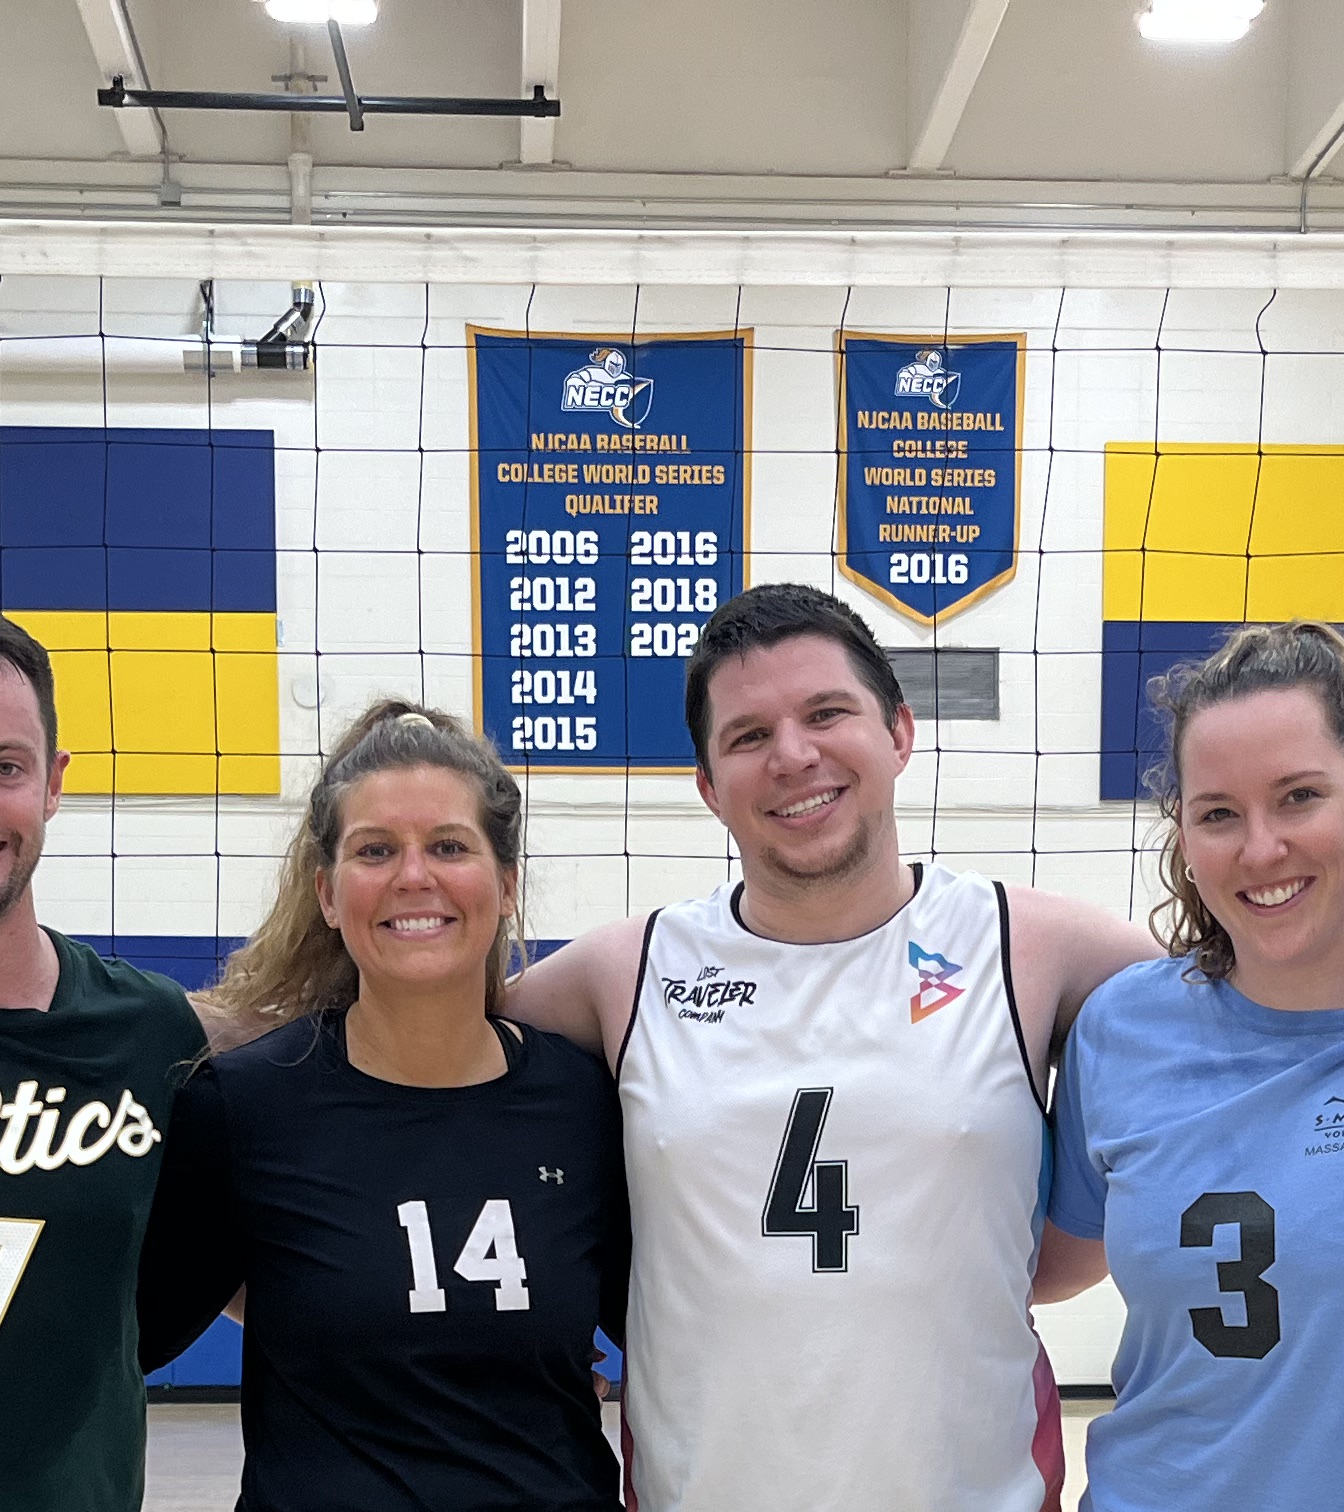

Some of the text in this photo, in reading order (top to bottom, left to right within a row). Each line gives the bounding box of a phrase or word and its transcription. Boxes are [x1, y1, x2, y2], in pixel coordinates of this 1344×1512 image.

[566, 385, 631, 407] NECC
[898, 377, 945, 393] NECC
[857, 410, 1004, 431] NJCAA BASEBALL
[530, 433, 691, 454] NJCAA BASEBALL
[892, 440, 968, 459] COLLEGE
[497, 462, 725, 485] COLLEGE WORLD SERIES
[864, 467, 996, 487] WORLD SERIES
[886, 495, 974, 515] NATIONAL
[878, 523, 980, 543] RUNNER-UP
[506, 530, 718, 565] 2006 2016
[889, 553, 969, 584] 2016
[510, 576, 718, 612] 2012 2018
[510, 622, 707, 657] 2013 202
[511, 670, 597, 704] 2014
[512, 716, 597, 750] 2015
[696, 966, 725, 982] LOST
[661, 977, 757, 1009] TRAVELER
[761, 1086, 860, 1273] 4
[396, 1199, 530, 1313] 14
[1179, 1191, 1281, 1360] 3
